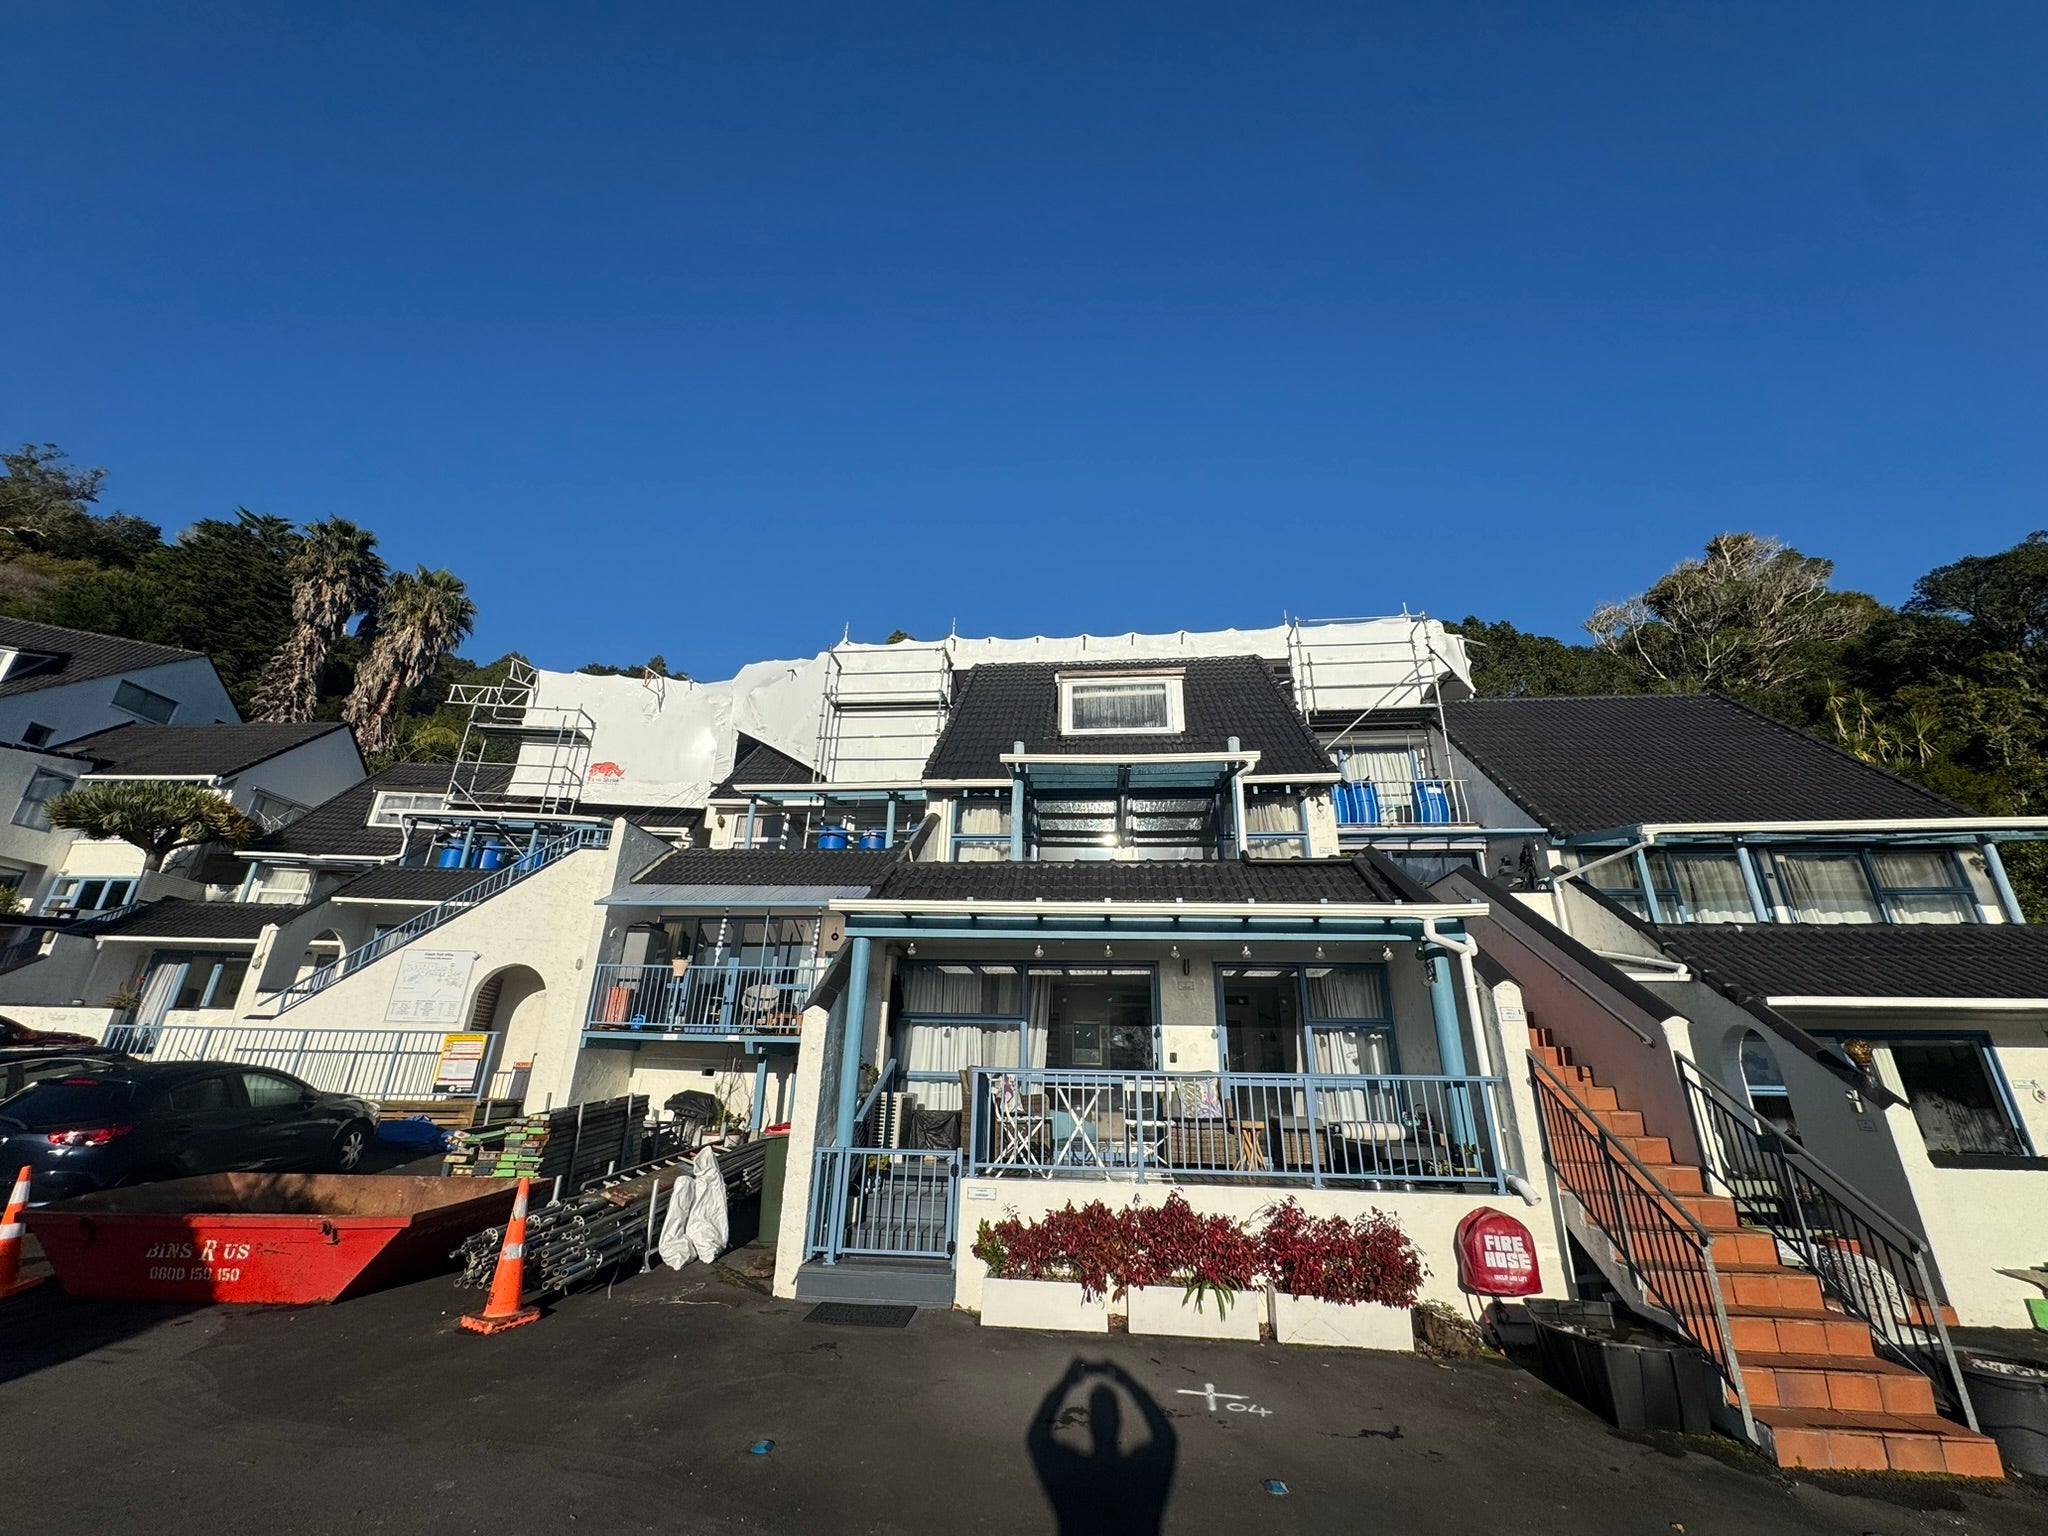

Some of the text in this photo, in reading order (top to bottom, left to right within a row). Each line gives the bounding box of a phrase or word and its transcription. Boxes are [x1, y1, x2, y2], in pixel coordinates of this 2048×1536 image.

[198, 1240, 218, 1262] R
[223, 1243, 251, 1260] US
[1484, 1234, 1524, 1254] FIRE
[1484, 1251, 1532, 1270] HOSE
[149, 1266, 241, 1282] 0800 150 150
[1226, 1403, 1272, 1417] 04
